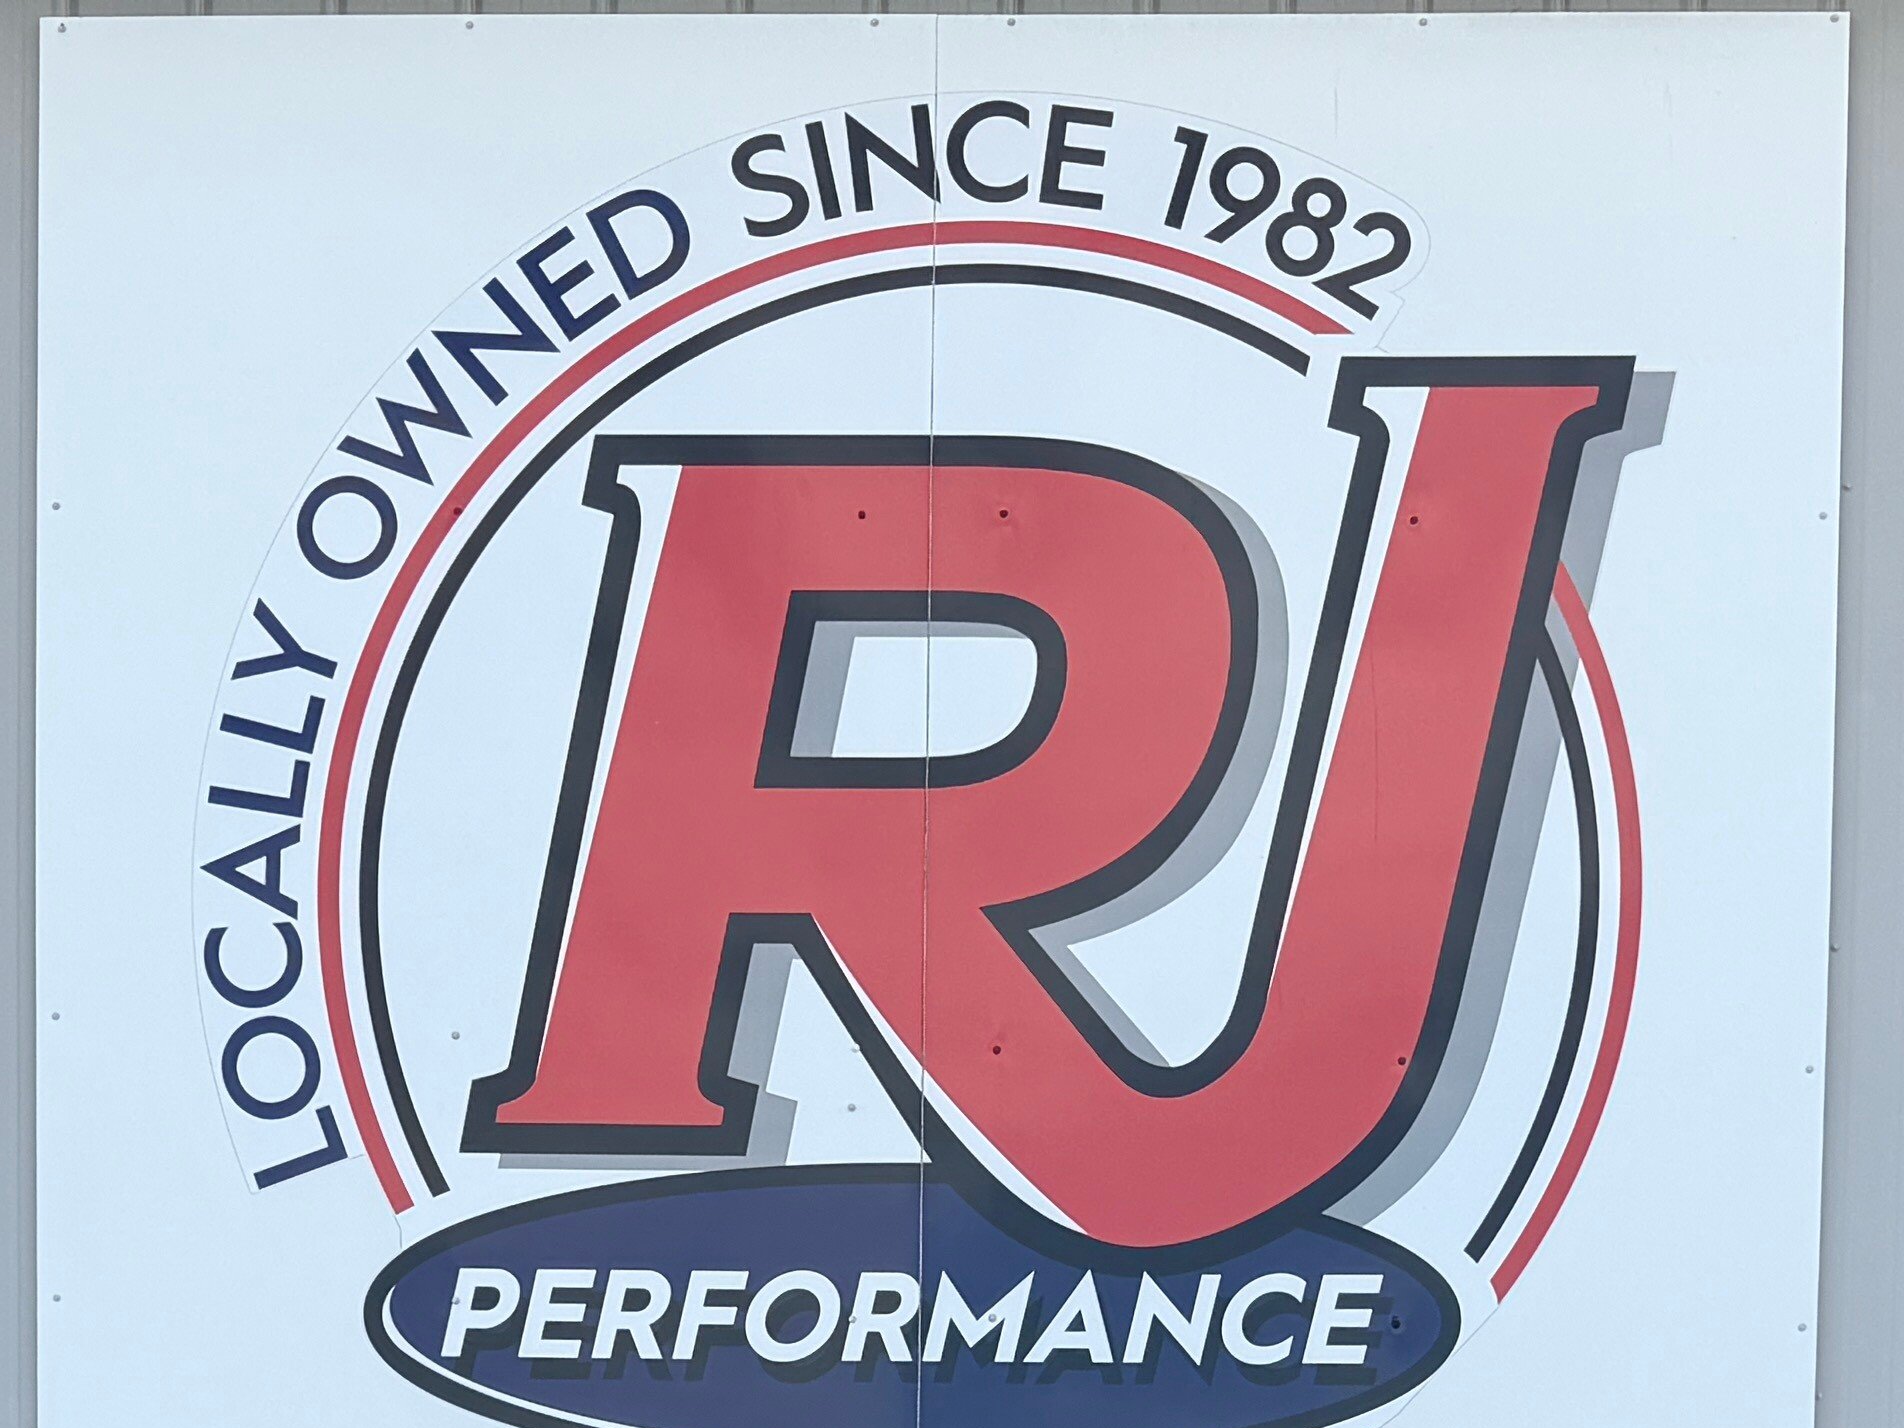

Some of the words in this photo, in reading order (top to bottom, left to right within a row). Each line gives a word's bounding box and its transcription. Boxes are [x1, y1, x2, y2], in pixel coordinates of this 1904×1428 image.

[200, 597, 349, 1191] LOCALLY
[295, 188, 692, 581] OWNED
[731, 100, 1114, 239] SINCE
[1163, 124, 1412, 321] 1982
[460, 354, 1636, 1250] RJ
[440, 1267, 1385, 1367] PERFORMANCE
